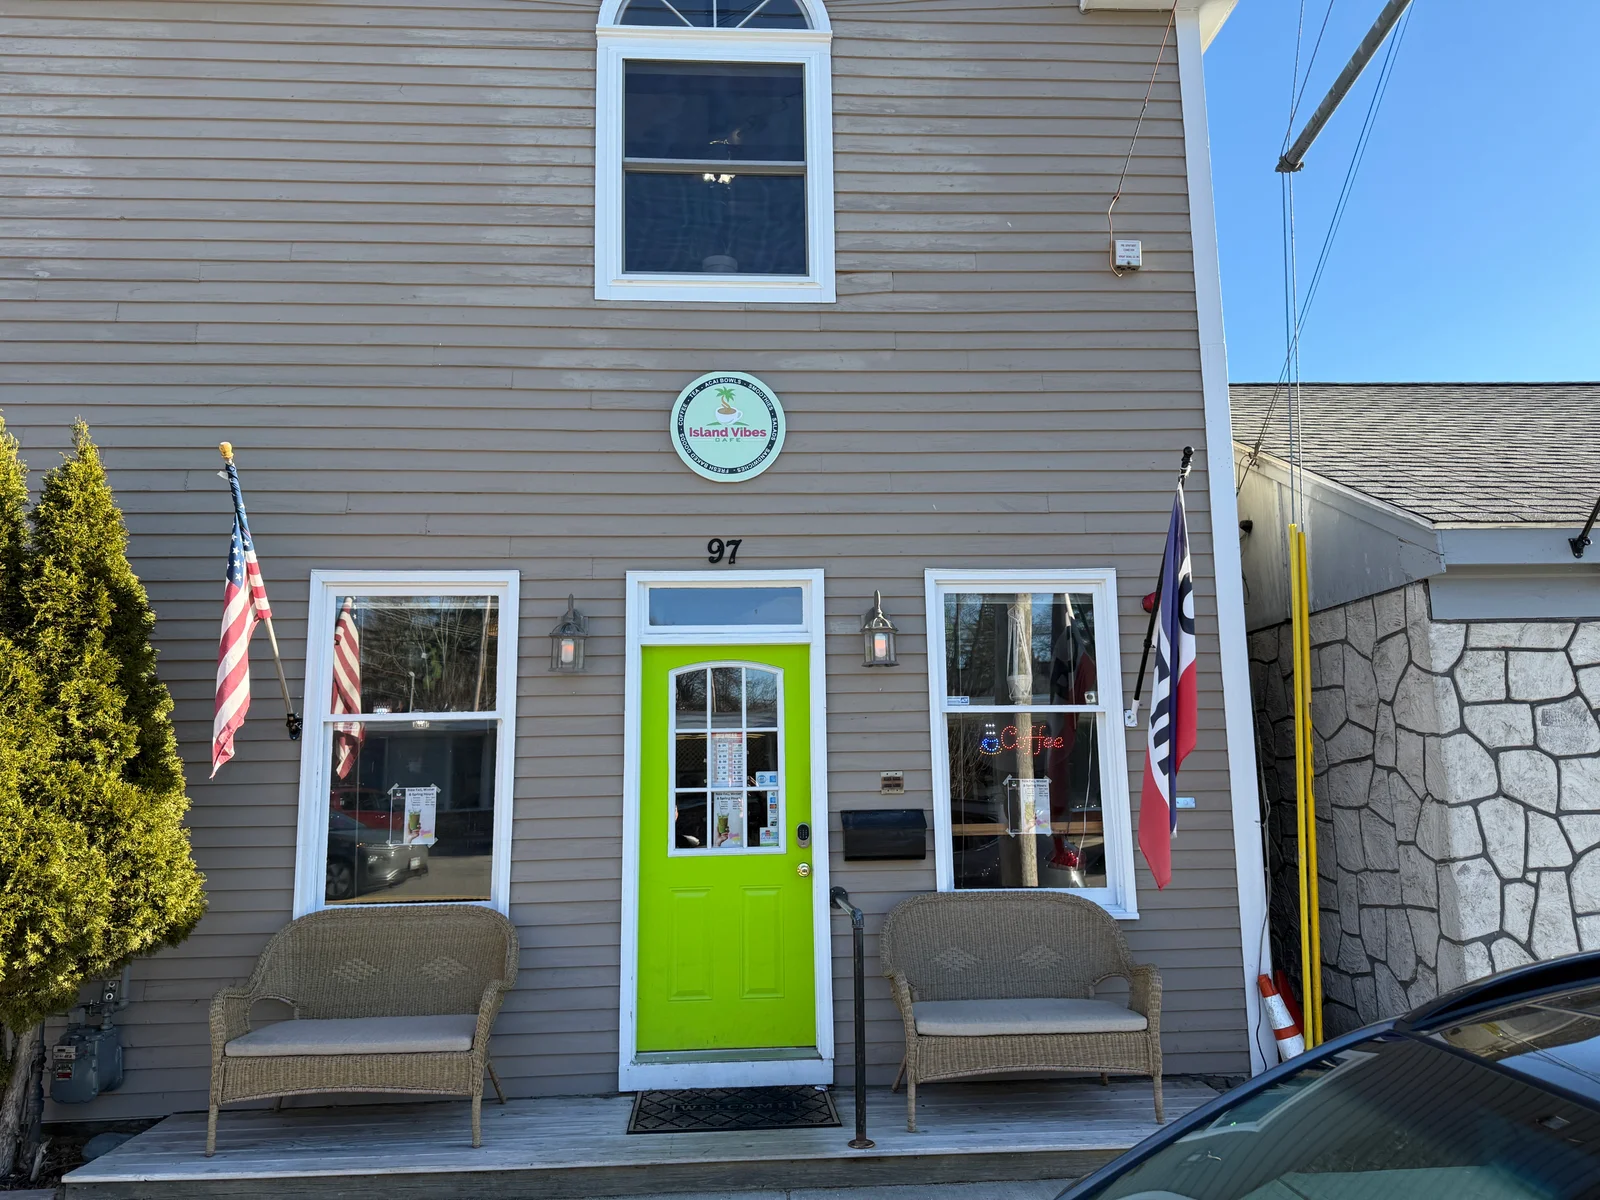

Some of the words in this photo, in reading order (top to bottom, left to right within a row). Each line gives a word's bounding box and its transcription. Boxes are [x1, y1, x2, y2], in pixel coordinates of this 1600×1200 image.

[689, 389, 699, 398] TEA
[747, 384, 773, 411] SMOOTHIES
[678, 404, 687, 426] COFFEE
[680, 433, 691, 453] GOODS
[689, 427, 728, 437] Island
[731, 427, 767, 437] Vibes
[737, 449, 770, 473] SANDWICHES
[707, 538, 742, 565] 97
[1001, 725, 1064, 755] Coffee
[680, 1102, 789, 1112] WELCOME
